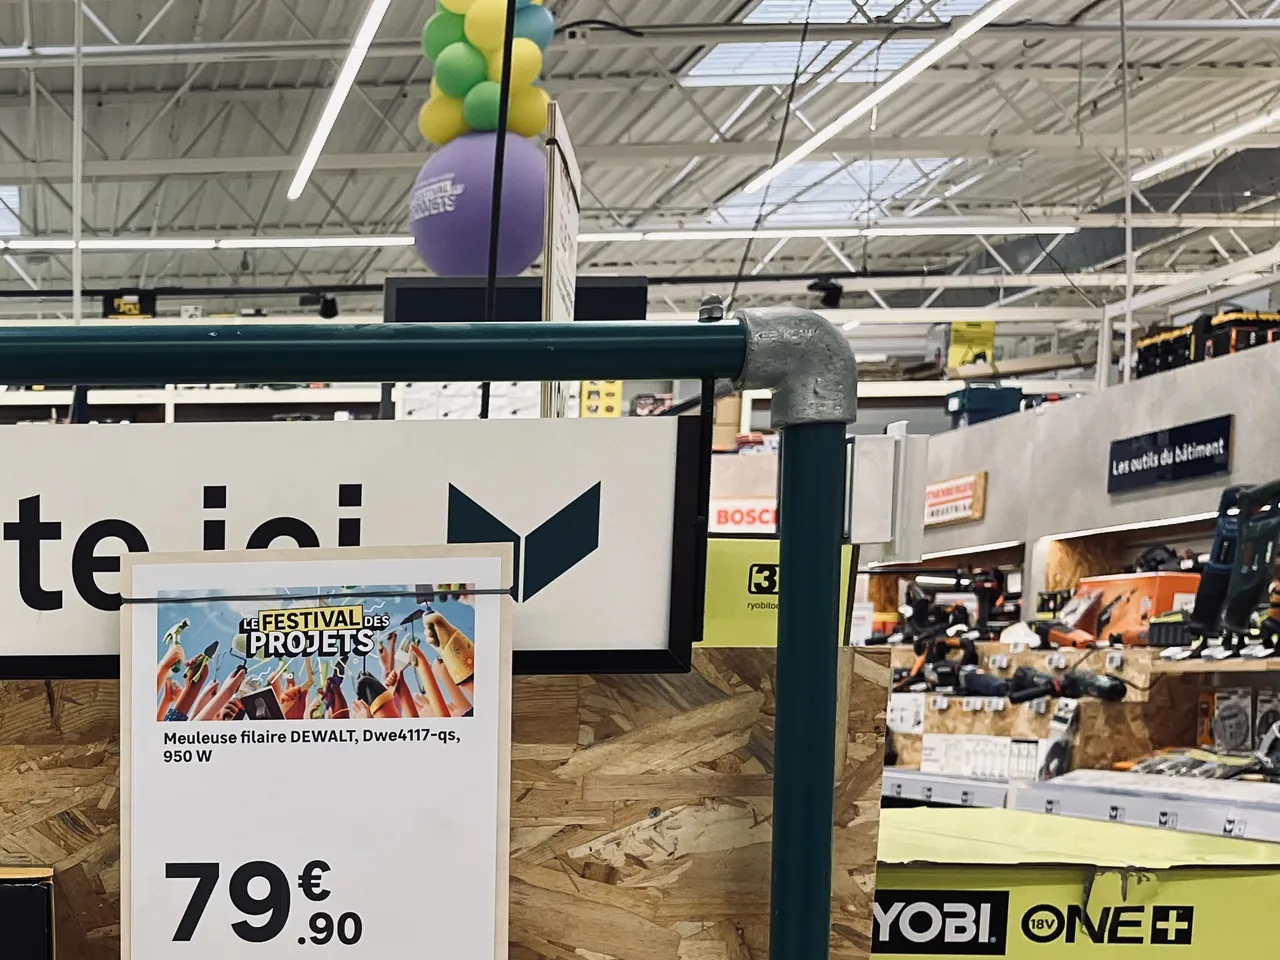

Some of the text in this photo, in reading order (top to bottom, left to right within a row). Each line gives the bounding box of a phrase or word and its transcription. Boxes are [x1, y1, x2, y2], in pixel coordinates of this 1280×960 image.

[1112, 437, 1224, 475] Les outils du bâtiment
[242, 608, 390, 631] LE FESTIVAL DES
[250, 631, 375, 655] PROJETS
[163, 727, 461, 745] Meuleuse filaire DEWALT, Dwe4117-qs,
[163, 749, 212, 763] 950 W
[165, 859, 363, 945] 79 € .90
[874, 902, 991, 943] YOBI
[1030, 919, 1055, 930] 18V
